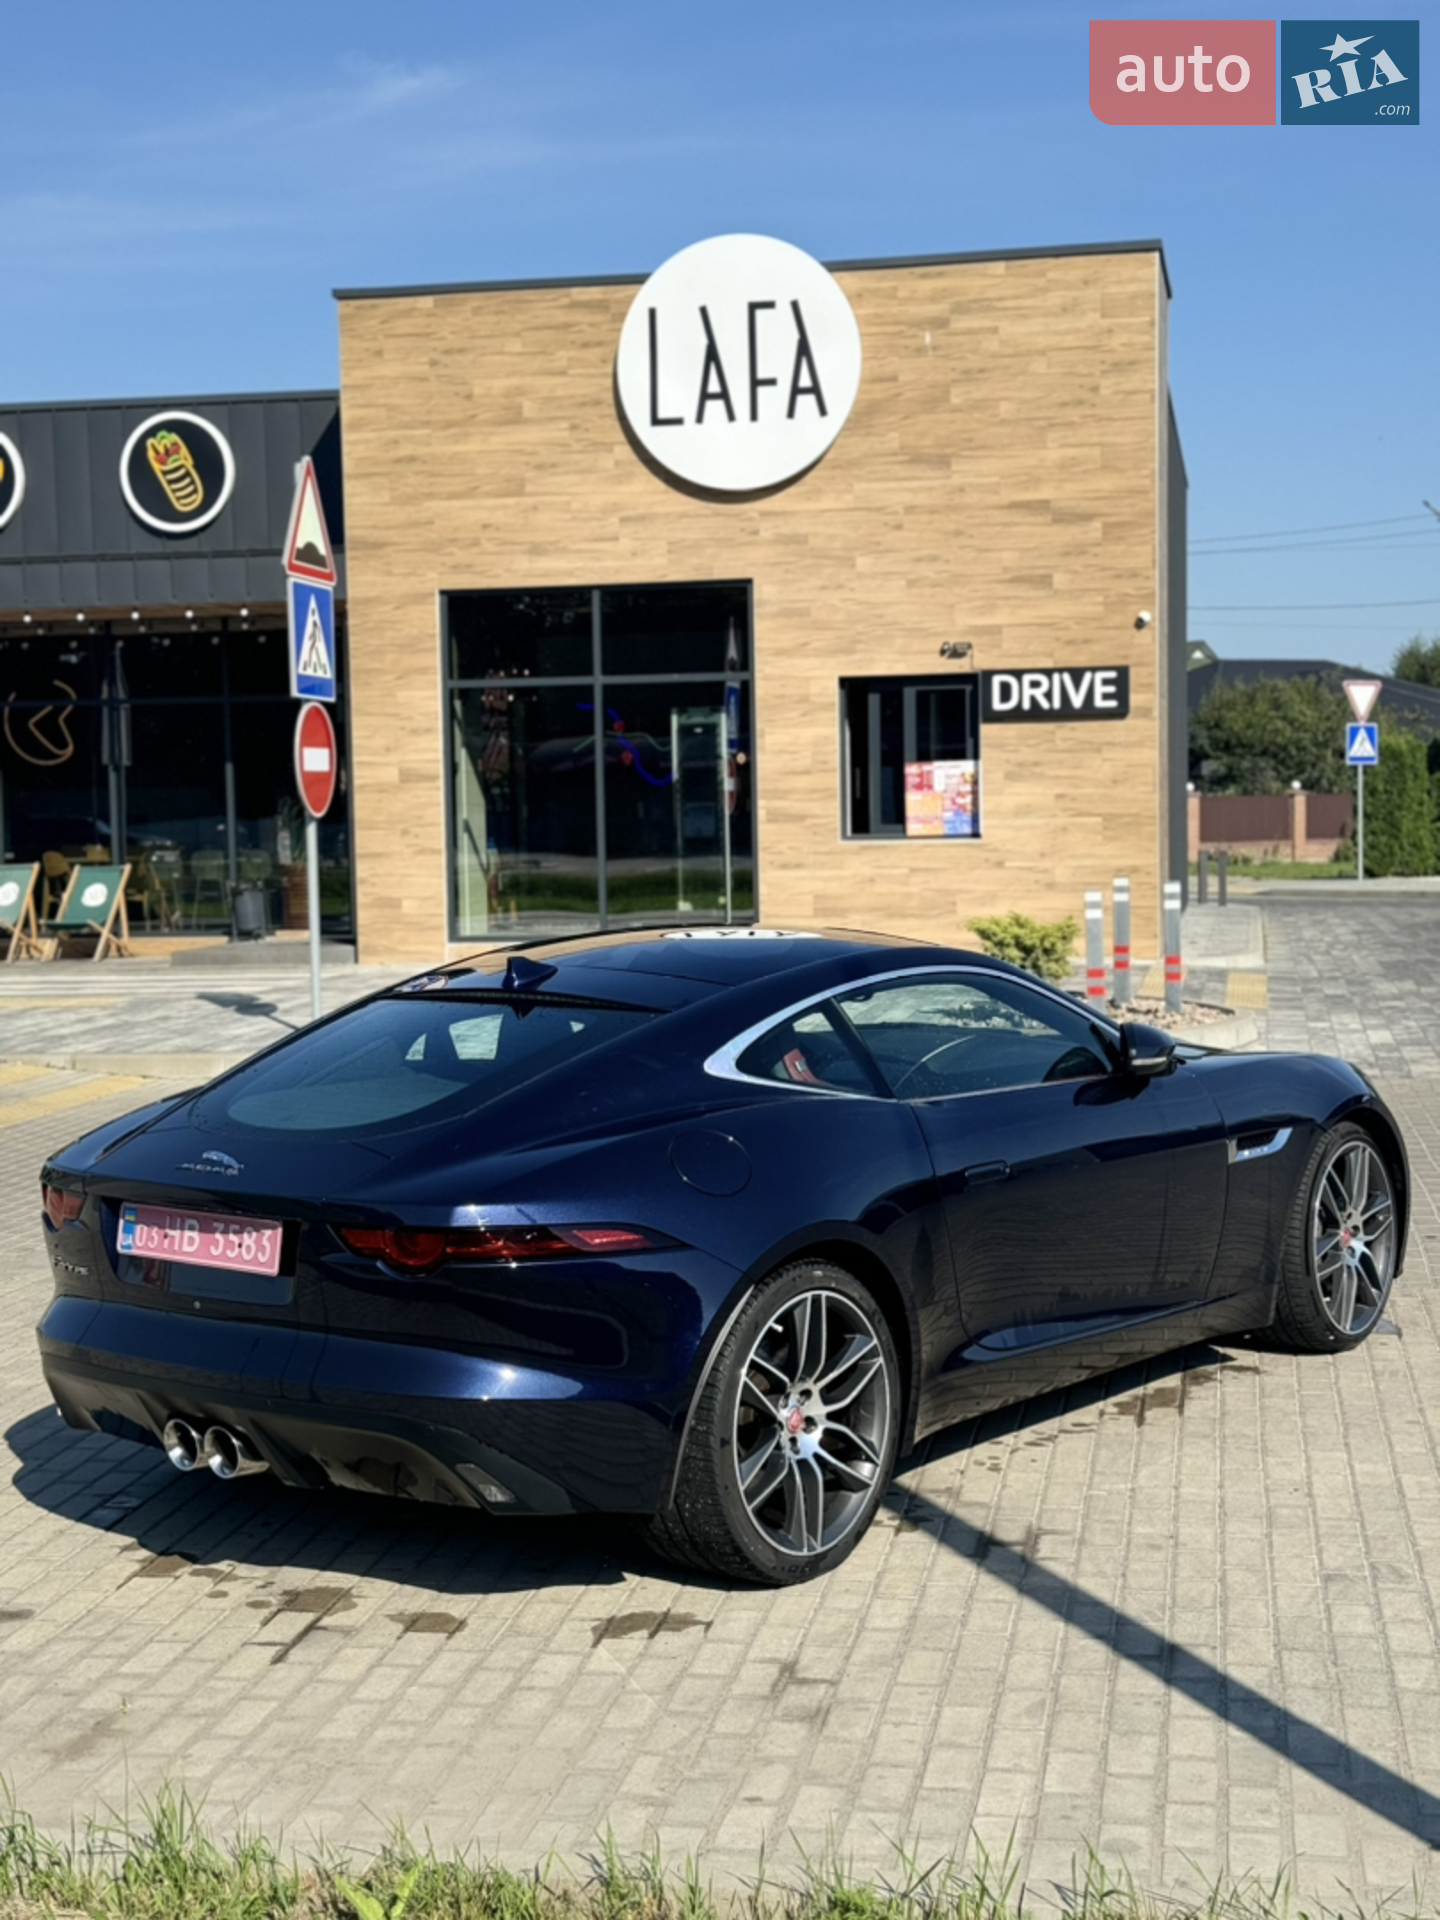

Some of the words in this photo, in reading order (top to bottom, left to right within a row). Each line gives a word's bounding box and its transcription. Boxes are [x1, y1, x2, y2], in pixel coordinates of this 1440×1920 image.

[648, 299, 828, 427] LAFA
[991, 670, 1119, 711] DRIVE
[209, 1221, 272, 1264] 3583
